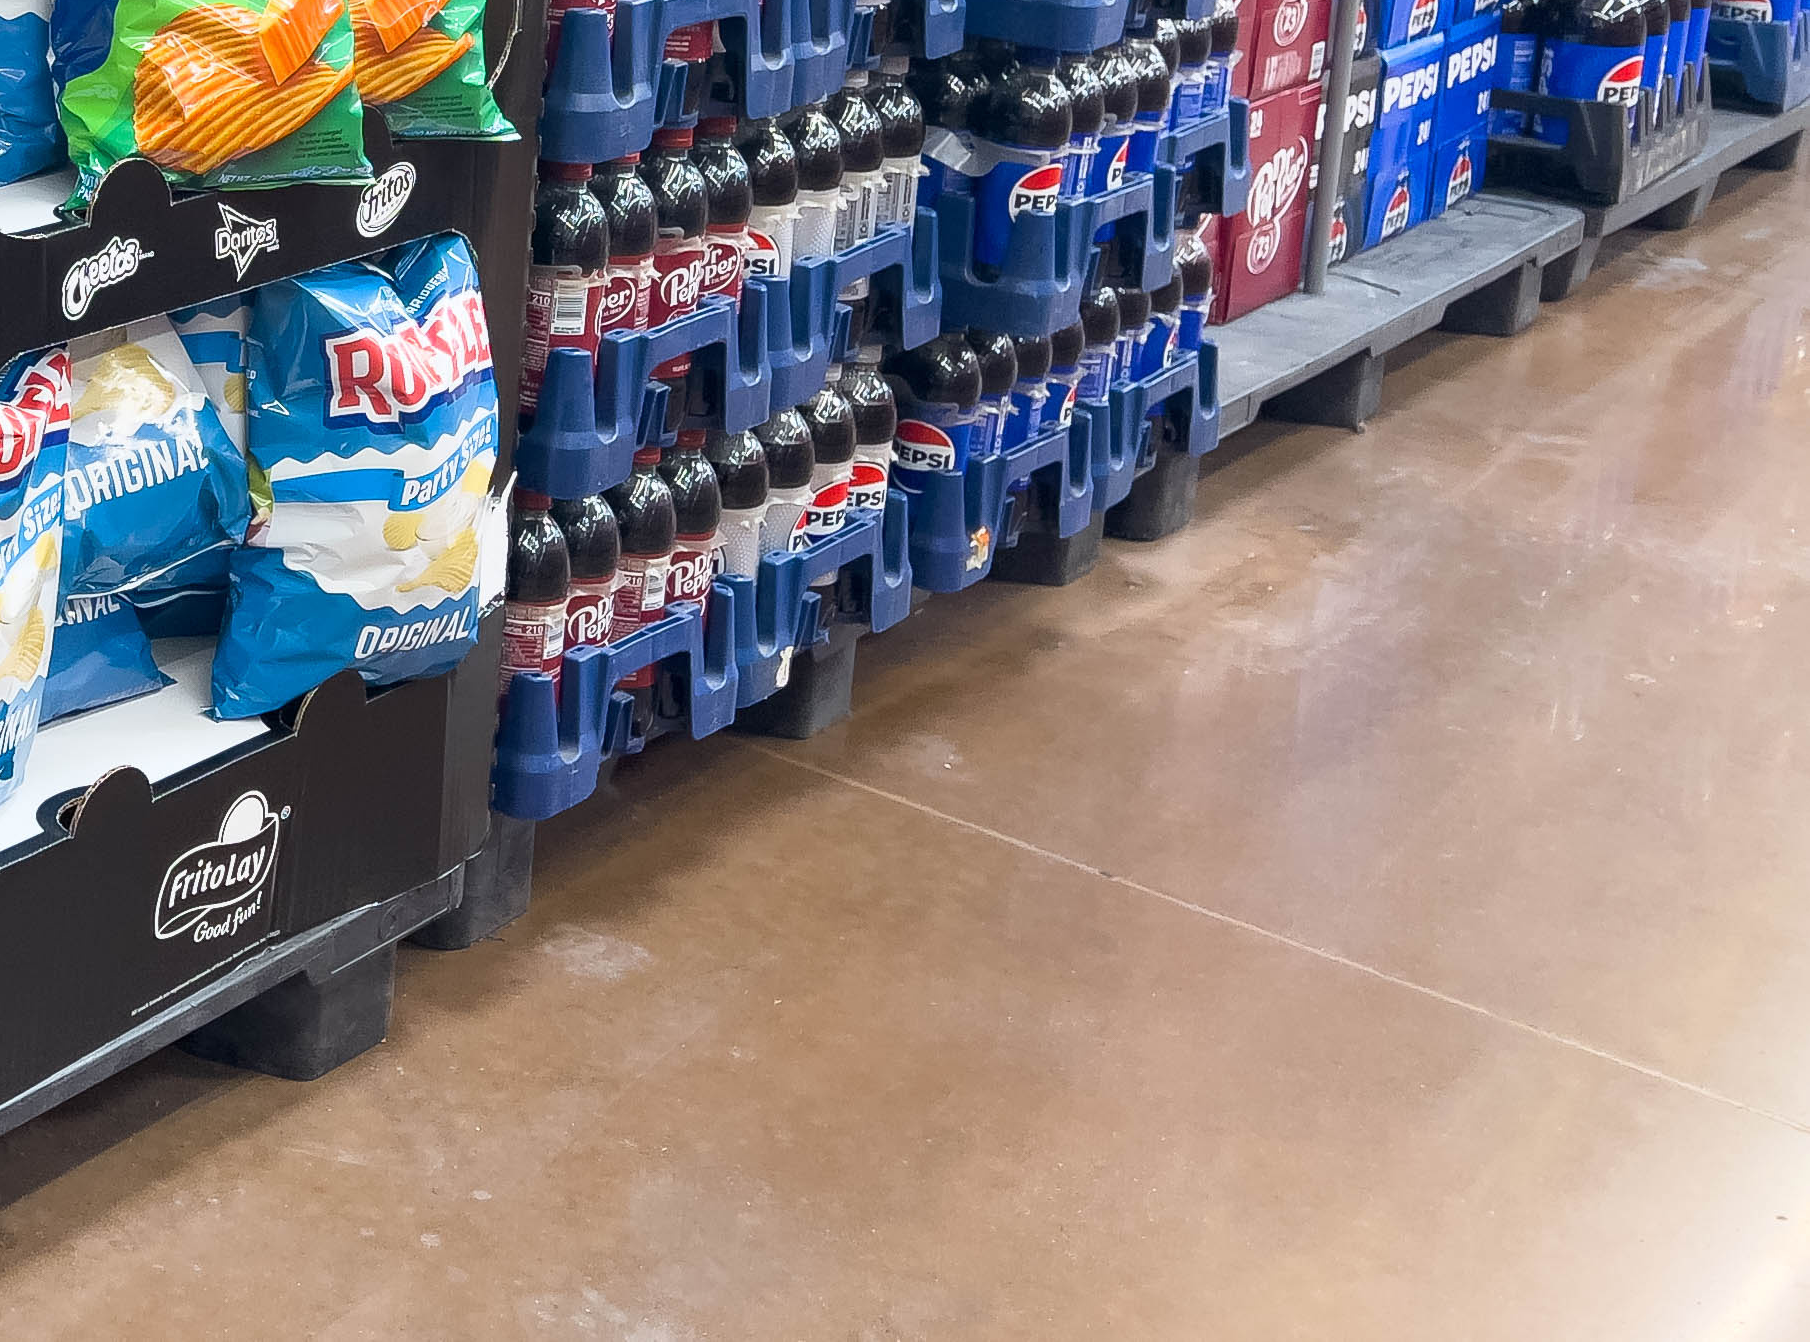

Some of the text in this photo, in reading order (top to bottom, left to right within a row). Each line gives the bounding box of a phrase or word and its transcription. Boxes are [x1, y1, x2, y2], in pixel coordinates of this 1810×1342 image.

[1383, 61, 1439, 114] PEPSI
[1447, 37, 1498, 87] PEPSI
[362, 171, 412, 224] Fritos
[217, 221, 276, 256] Doritos
[63, 239, 138, 320] Cheetos
[400, 457, 457, 506] Party
[23, 487, 64, 541] Size!
[354, 609, 471, 660] ORIGINAL
[192, 893, 263, 943] Good fun!
